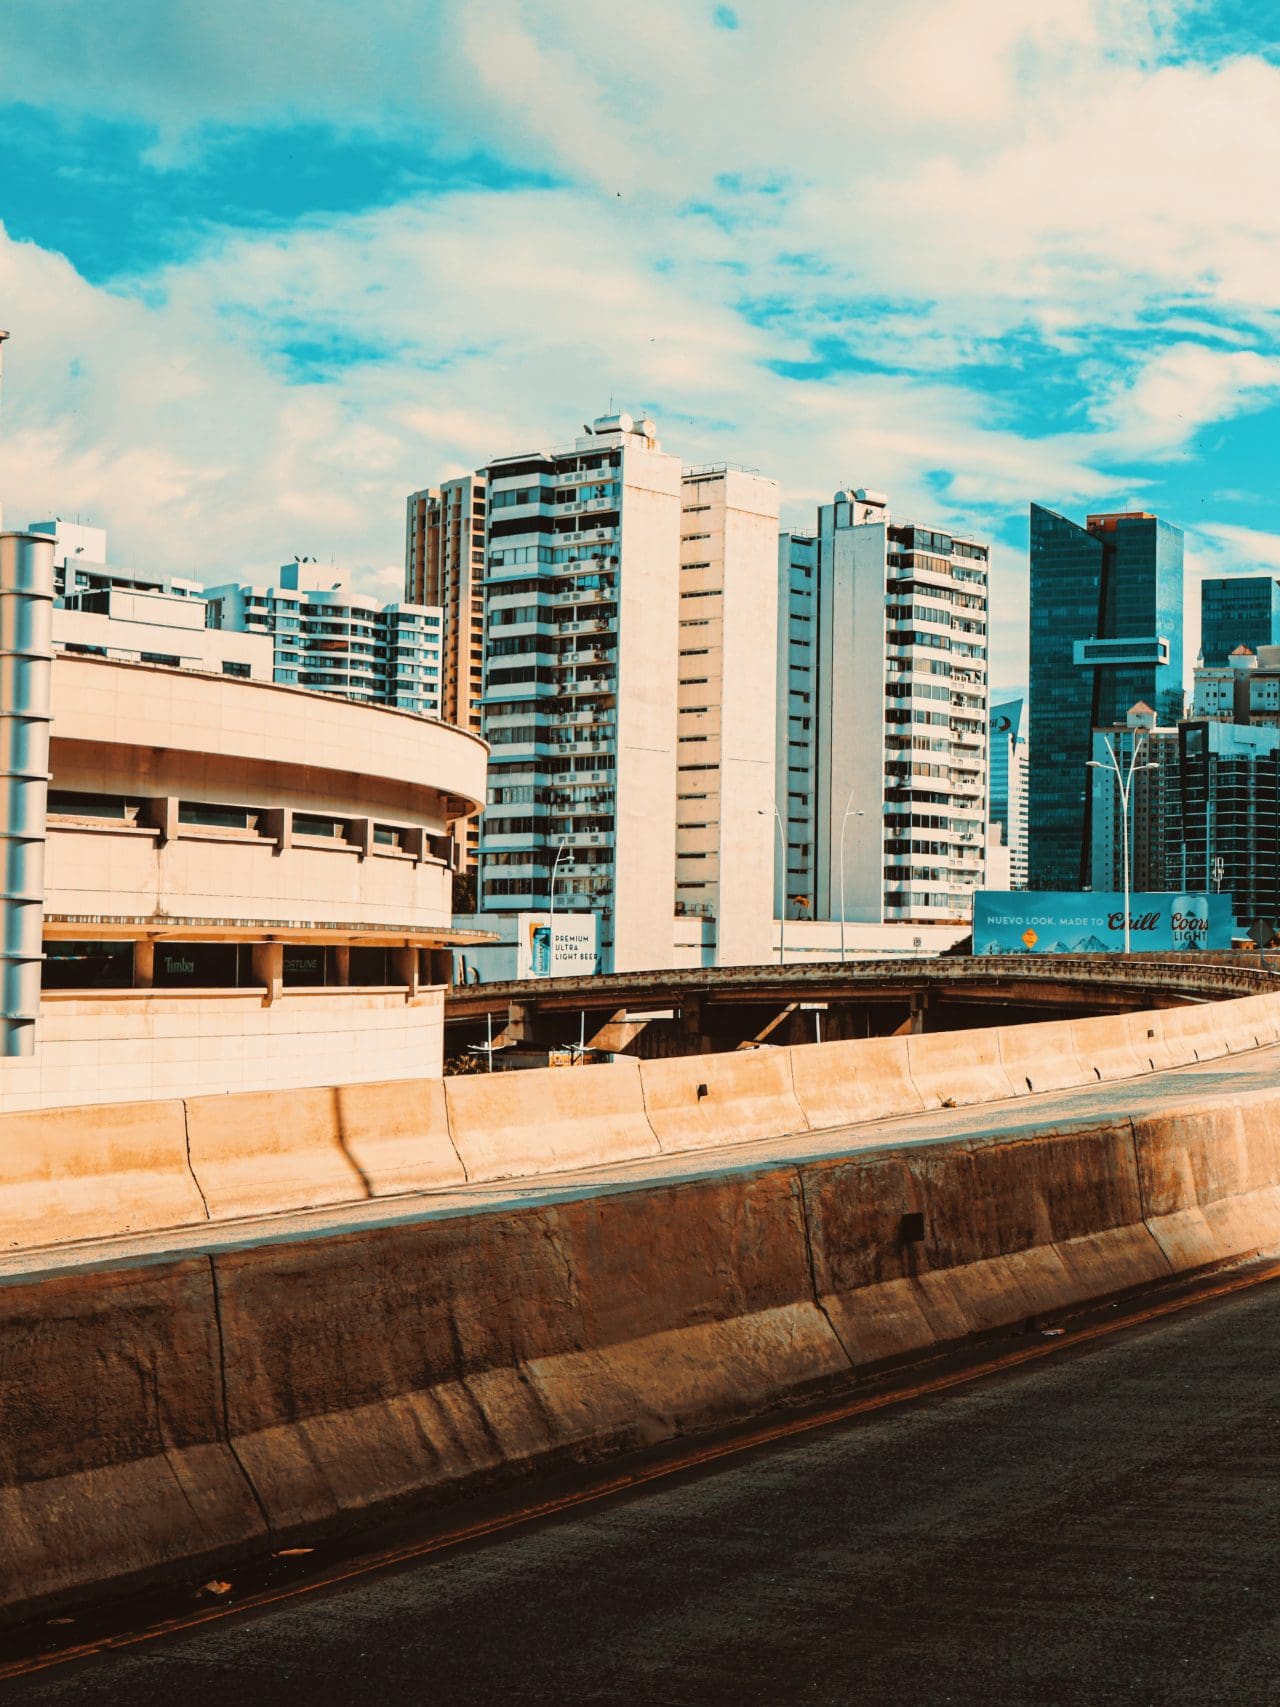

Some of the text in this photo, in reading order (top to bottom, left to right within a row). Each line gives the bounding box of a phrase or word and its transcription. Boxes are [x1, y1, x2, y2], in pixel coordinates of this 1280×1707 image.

[987, 916, 1023, 925] NUEVO
[1059, 917, 1088, 926] MADE
[1090, 917, 1104, 927] TO
[1107, 912, 1160, 931] Chill
[1171, 912, 1209, 931] Coors
[555, 935, 589, 943] PREMIUM
[1174, 931, 1206, 941] LIGHT
[555, 943, 579, 951] ULTRA
[555, 953, 598, 961] LIGHT BEER
[164, 955, 195, 974] Timber
